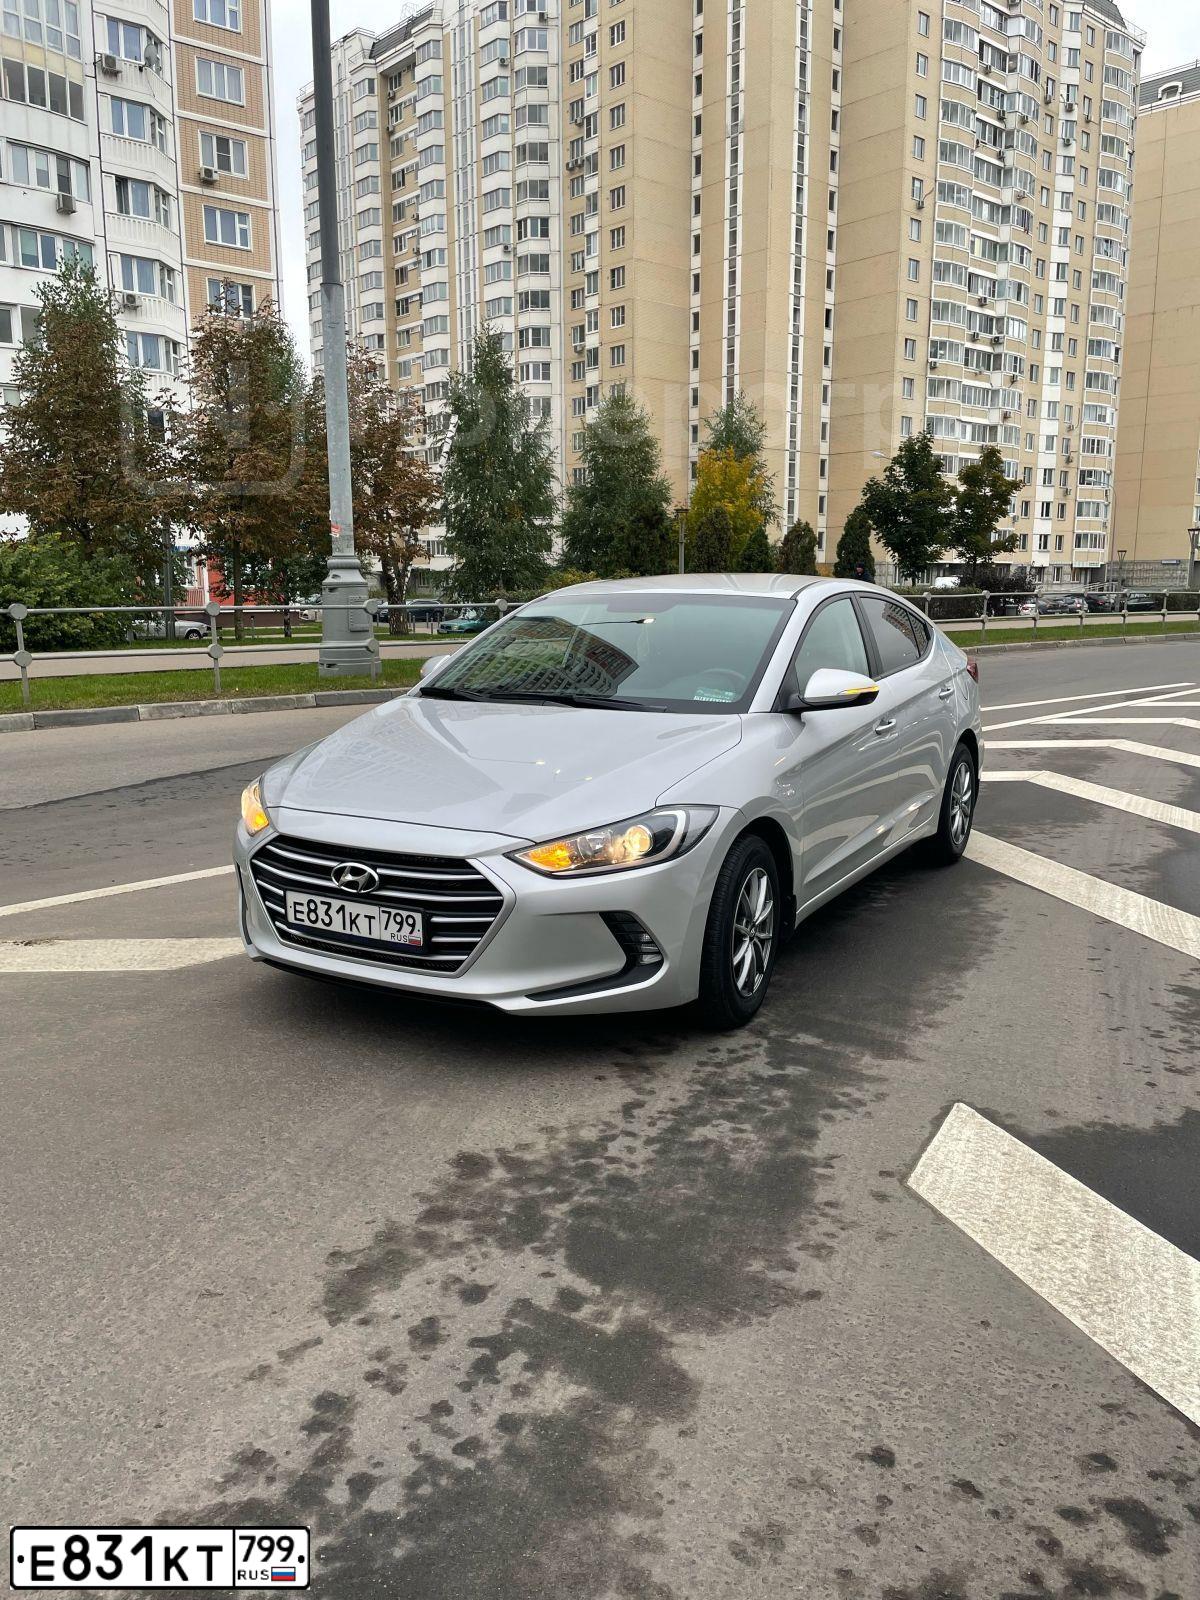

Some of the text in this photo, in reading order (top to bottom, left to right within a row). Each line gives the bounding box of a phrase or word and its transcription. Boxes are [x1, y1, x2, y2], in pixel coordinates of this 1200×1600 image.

[293, 898, 417, 936] Е831КТ 799
[390, 932, 408, 943] RUS
